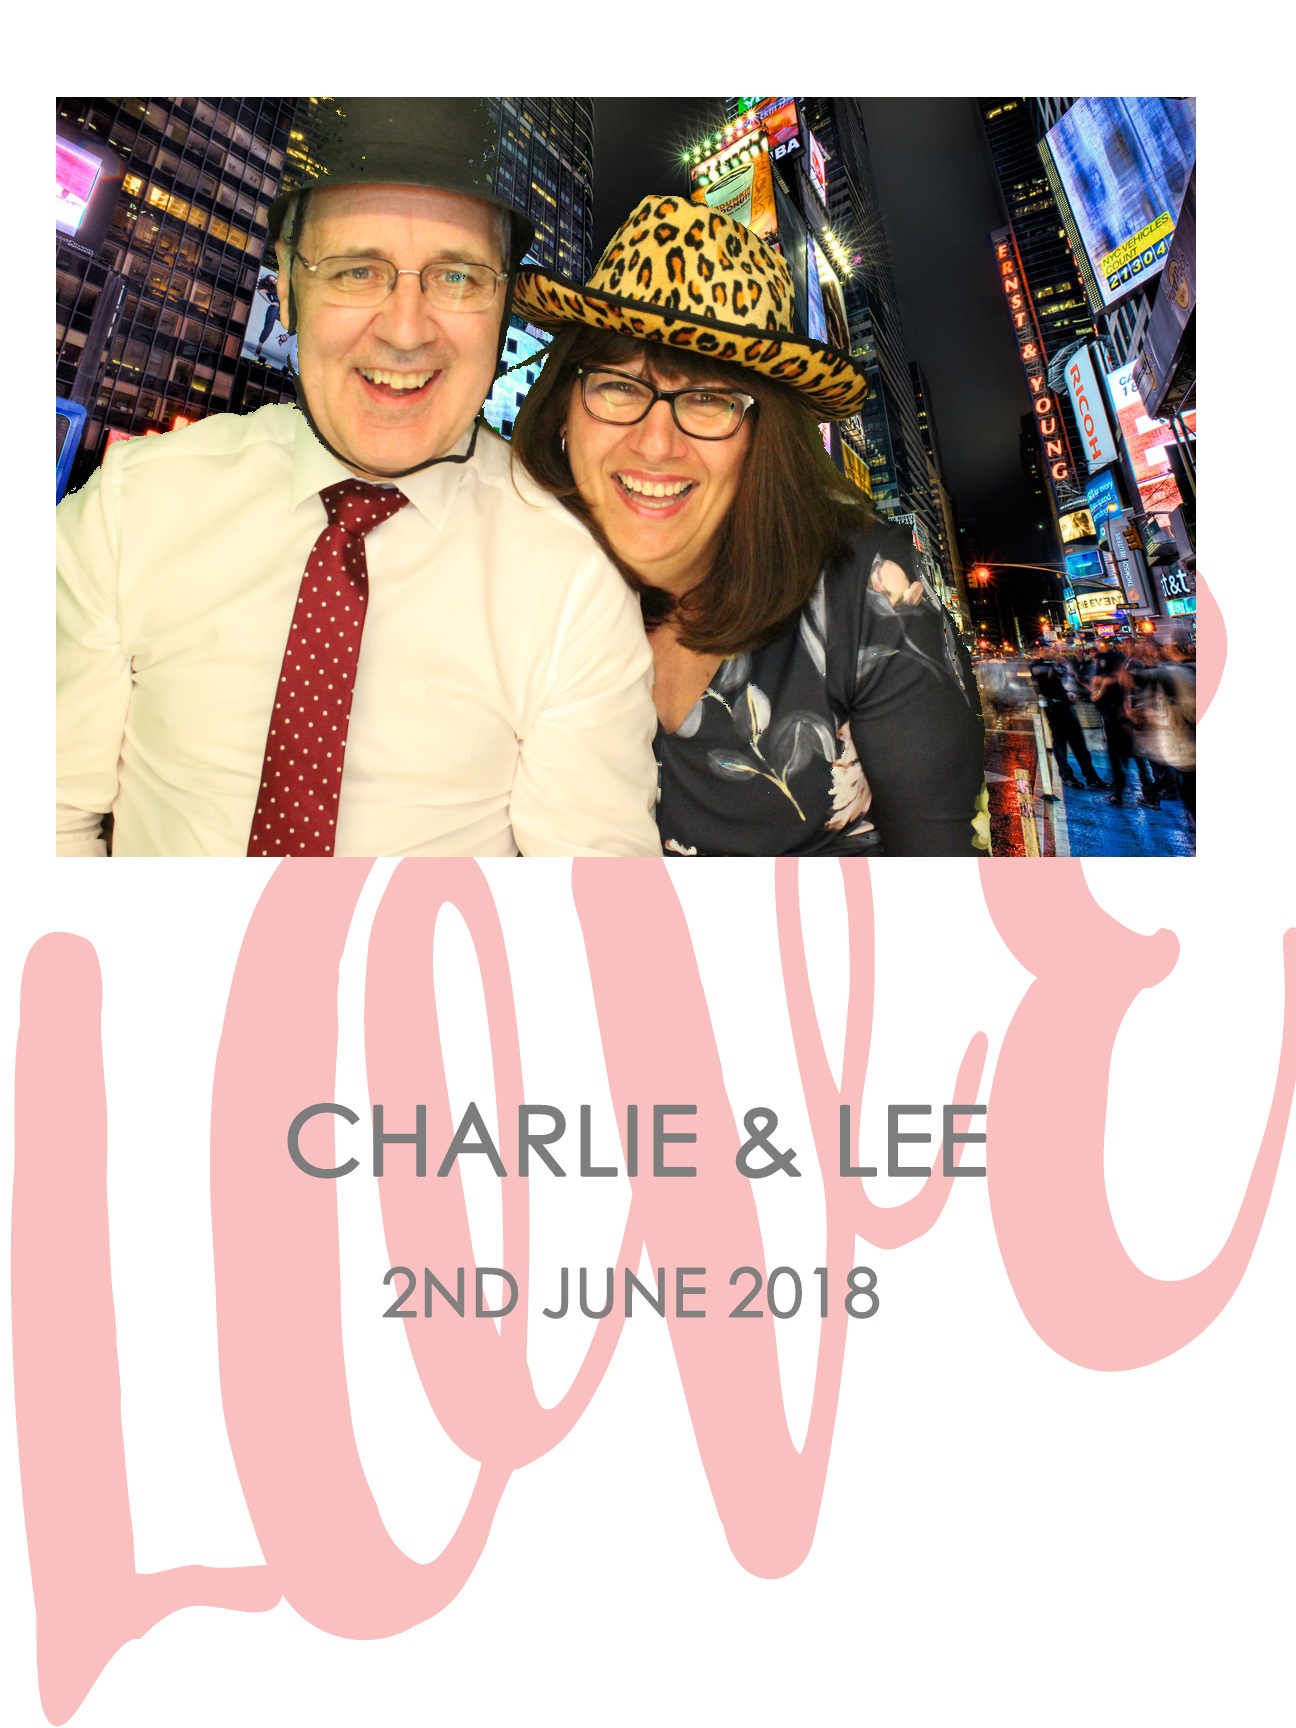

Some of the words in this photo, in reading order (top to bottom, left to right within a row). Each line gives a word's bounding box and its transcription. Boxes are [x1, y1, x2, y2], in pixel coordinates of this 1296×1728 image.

[1102, 247, 1122, 267] NYC
[1121, 213, 1169, 251] VEHICLES
[1105, 246, 1138, 275] COUNT
[997, 243, 1026, 328] ERNST
[1022, 343, 1037, 359] &
[1030, 376, 1068, 480] YOUNG
[1069, 363, 1102, 460] RICOH
[1116, 532, 1126, 559] REUTERS
